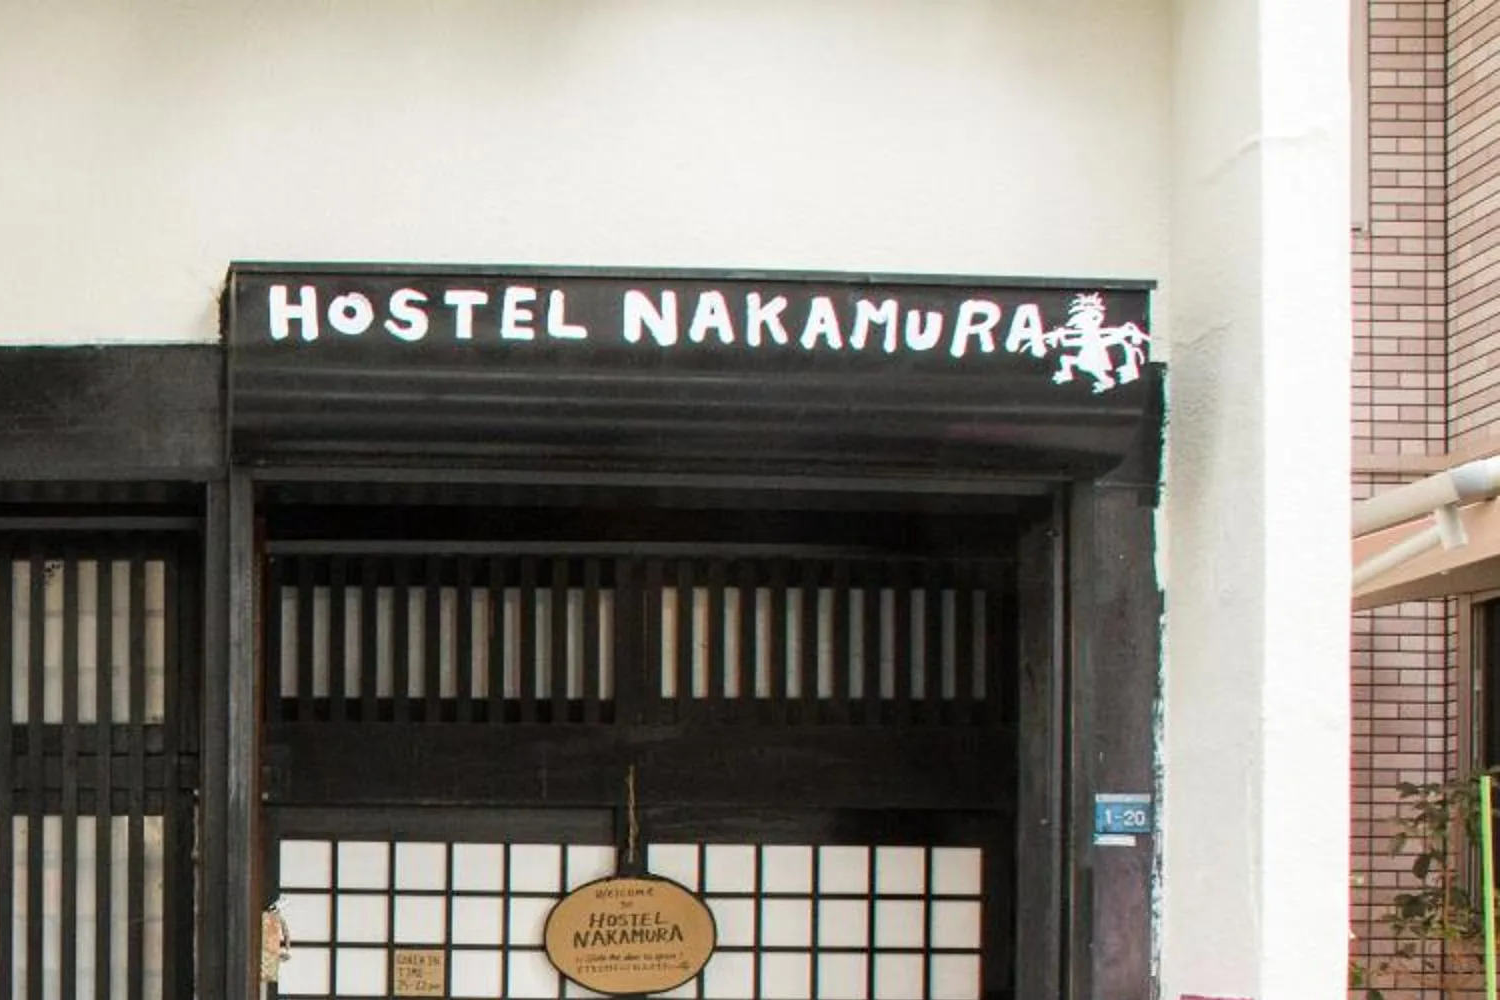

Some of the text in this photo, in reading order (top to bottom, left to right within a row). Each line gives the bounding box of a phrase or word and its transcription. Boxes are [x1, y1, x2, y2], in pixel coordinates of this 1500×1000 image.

[1105, 809, 1146, 827] 1-20
[589, 911, 668, 928] HOSTEL
[573, 924, 684, 949] NAKAMURA
